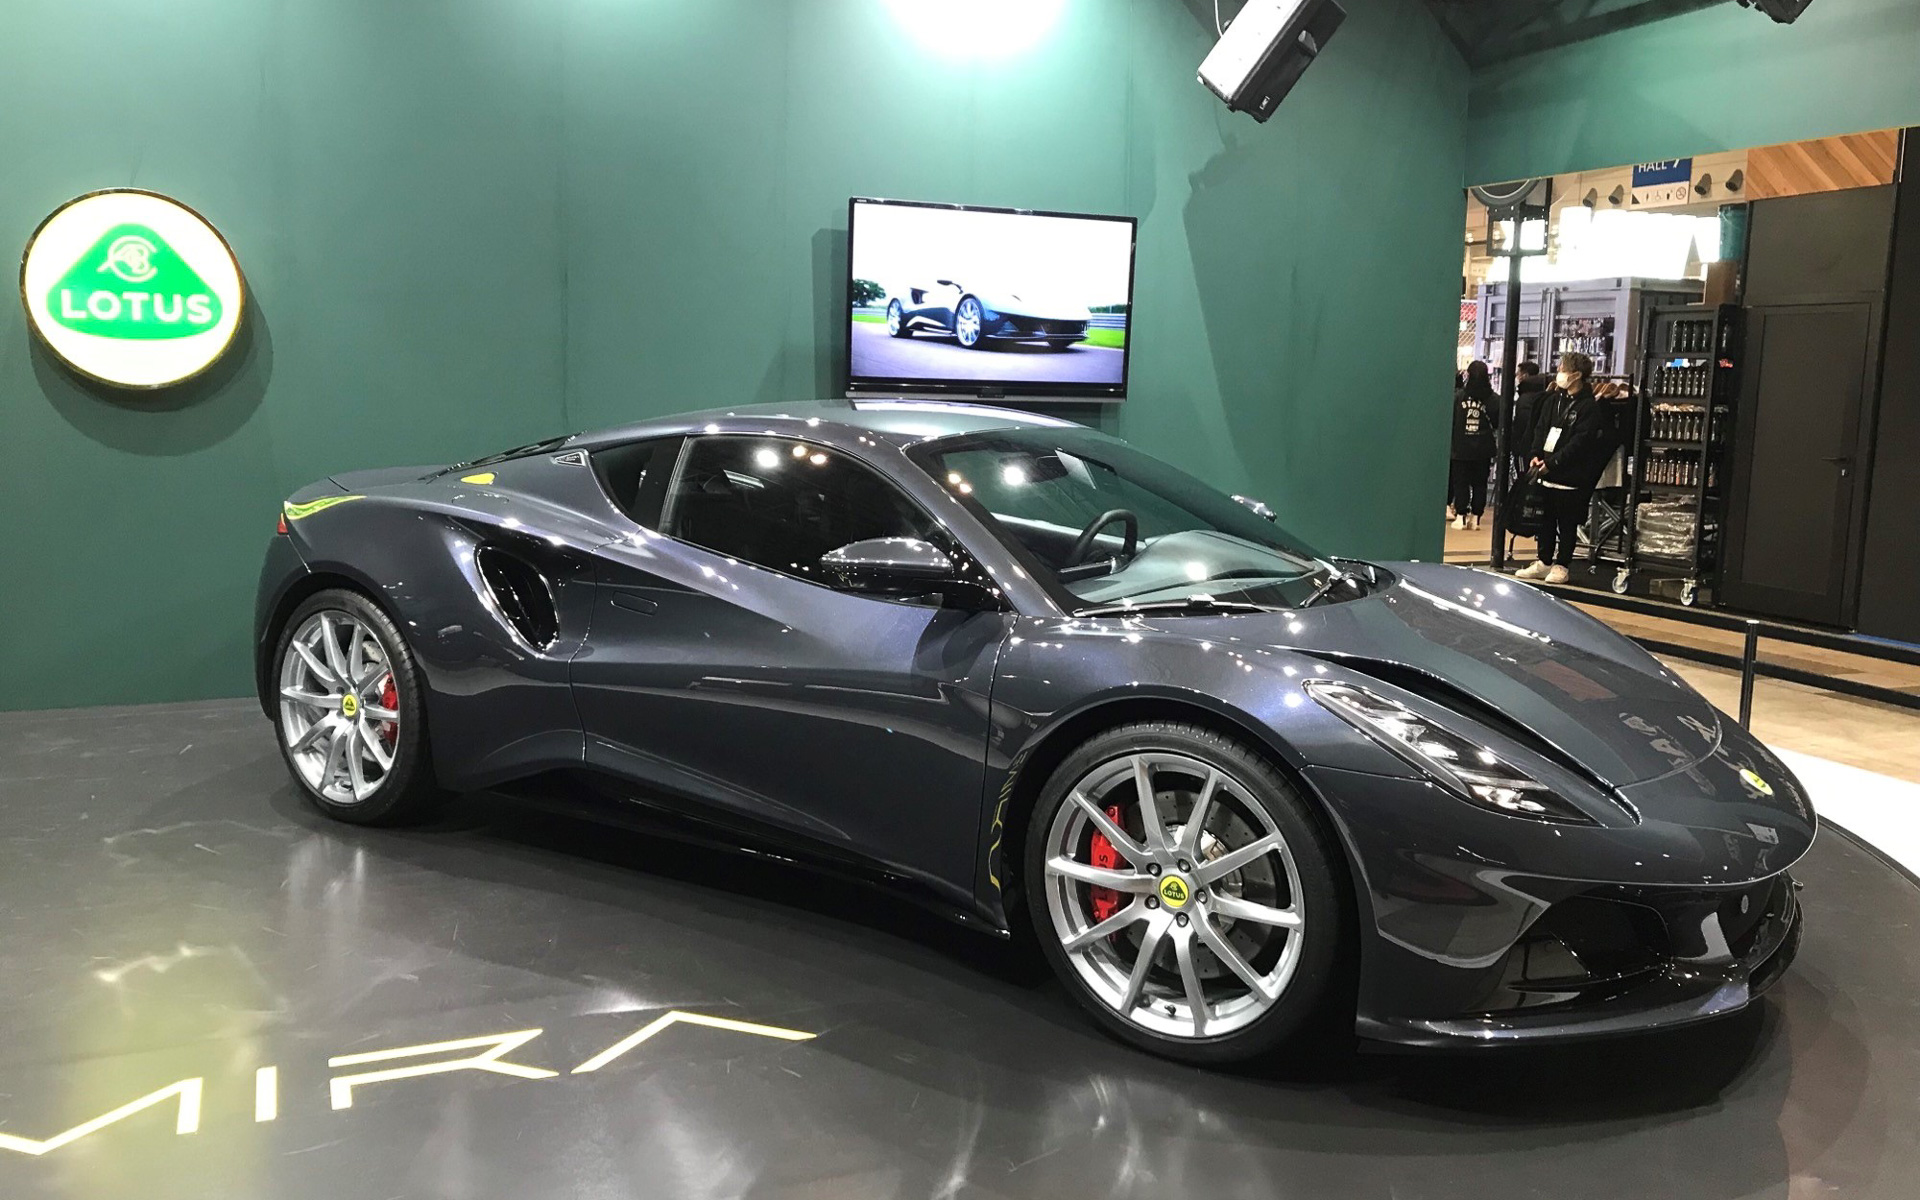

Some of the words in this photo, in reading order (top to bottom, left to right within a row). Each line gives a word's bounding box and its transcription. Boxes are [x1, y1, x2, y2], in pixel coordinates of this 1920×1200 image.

[1639, 161, 1667, 173] HALL
[61, 289, 212, 324] LOTUS
[1164, 889, 1185, 899] LOTUS
